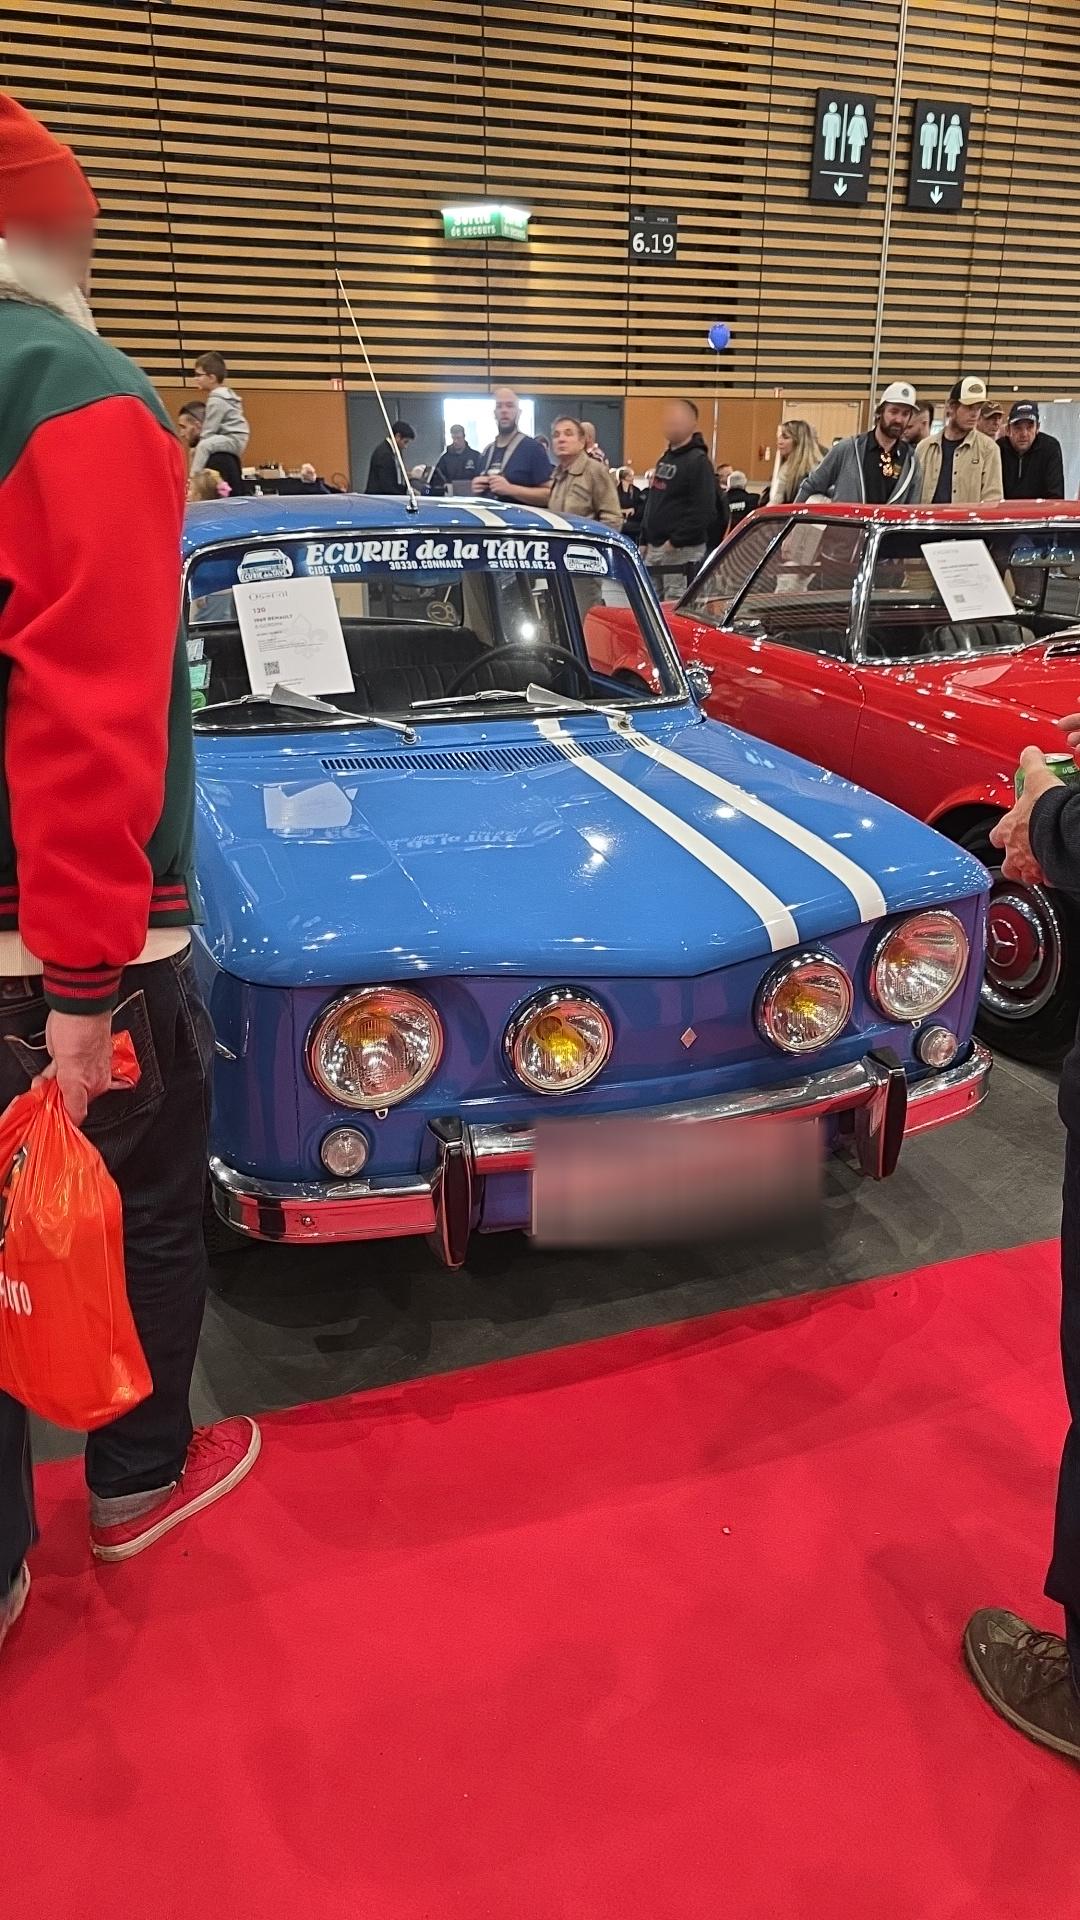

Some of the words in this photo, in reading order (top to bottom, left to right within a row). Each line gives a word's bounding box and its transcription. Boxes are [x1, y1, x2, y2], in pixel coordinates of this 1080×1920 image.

[450, 225, 461, 237] de
[463, 224, 496, 236] secours
[632, 232, 674, 254] 6.19
[306, 540, 408, 565] ECURIE
[416, 539, 448, 560] de
[453, 539, 479, 560] la
[483, 539, 549, 561] TAVE
[308, 565, 336, 575] CIDEX
[339, 563, 361, 573] 1000
